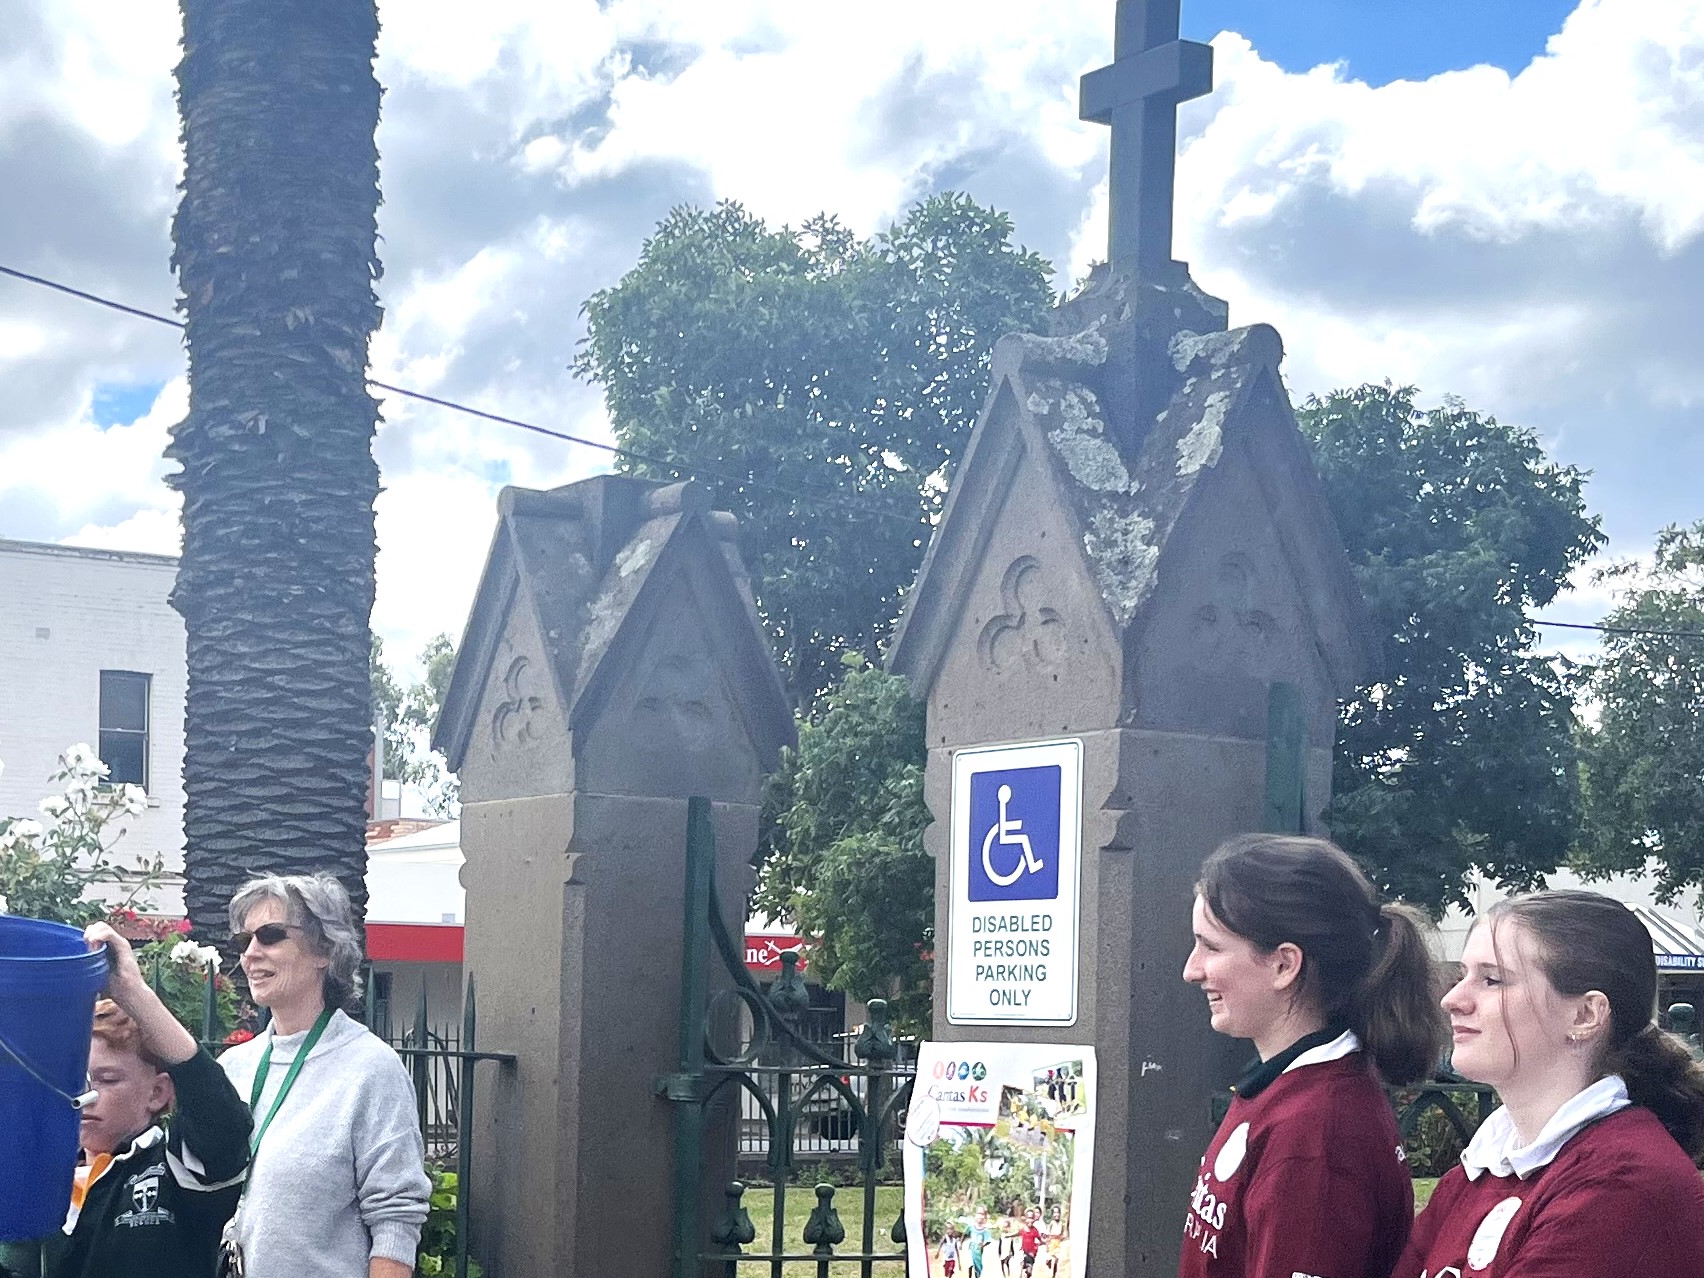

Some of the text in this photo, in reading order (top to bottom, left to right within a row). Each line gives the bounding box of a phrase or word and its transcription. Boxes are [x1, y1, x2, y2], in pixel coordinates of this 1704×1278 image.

[972, 914, 1053, 933] DISABLED
[973, 939, 1050, 958] PERSONS
[1656, 955, 1697, 967] DISABILITY
[975, 964, 1047, 982] PARKING
[989, 989, 1032, 1006] ONLY
